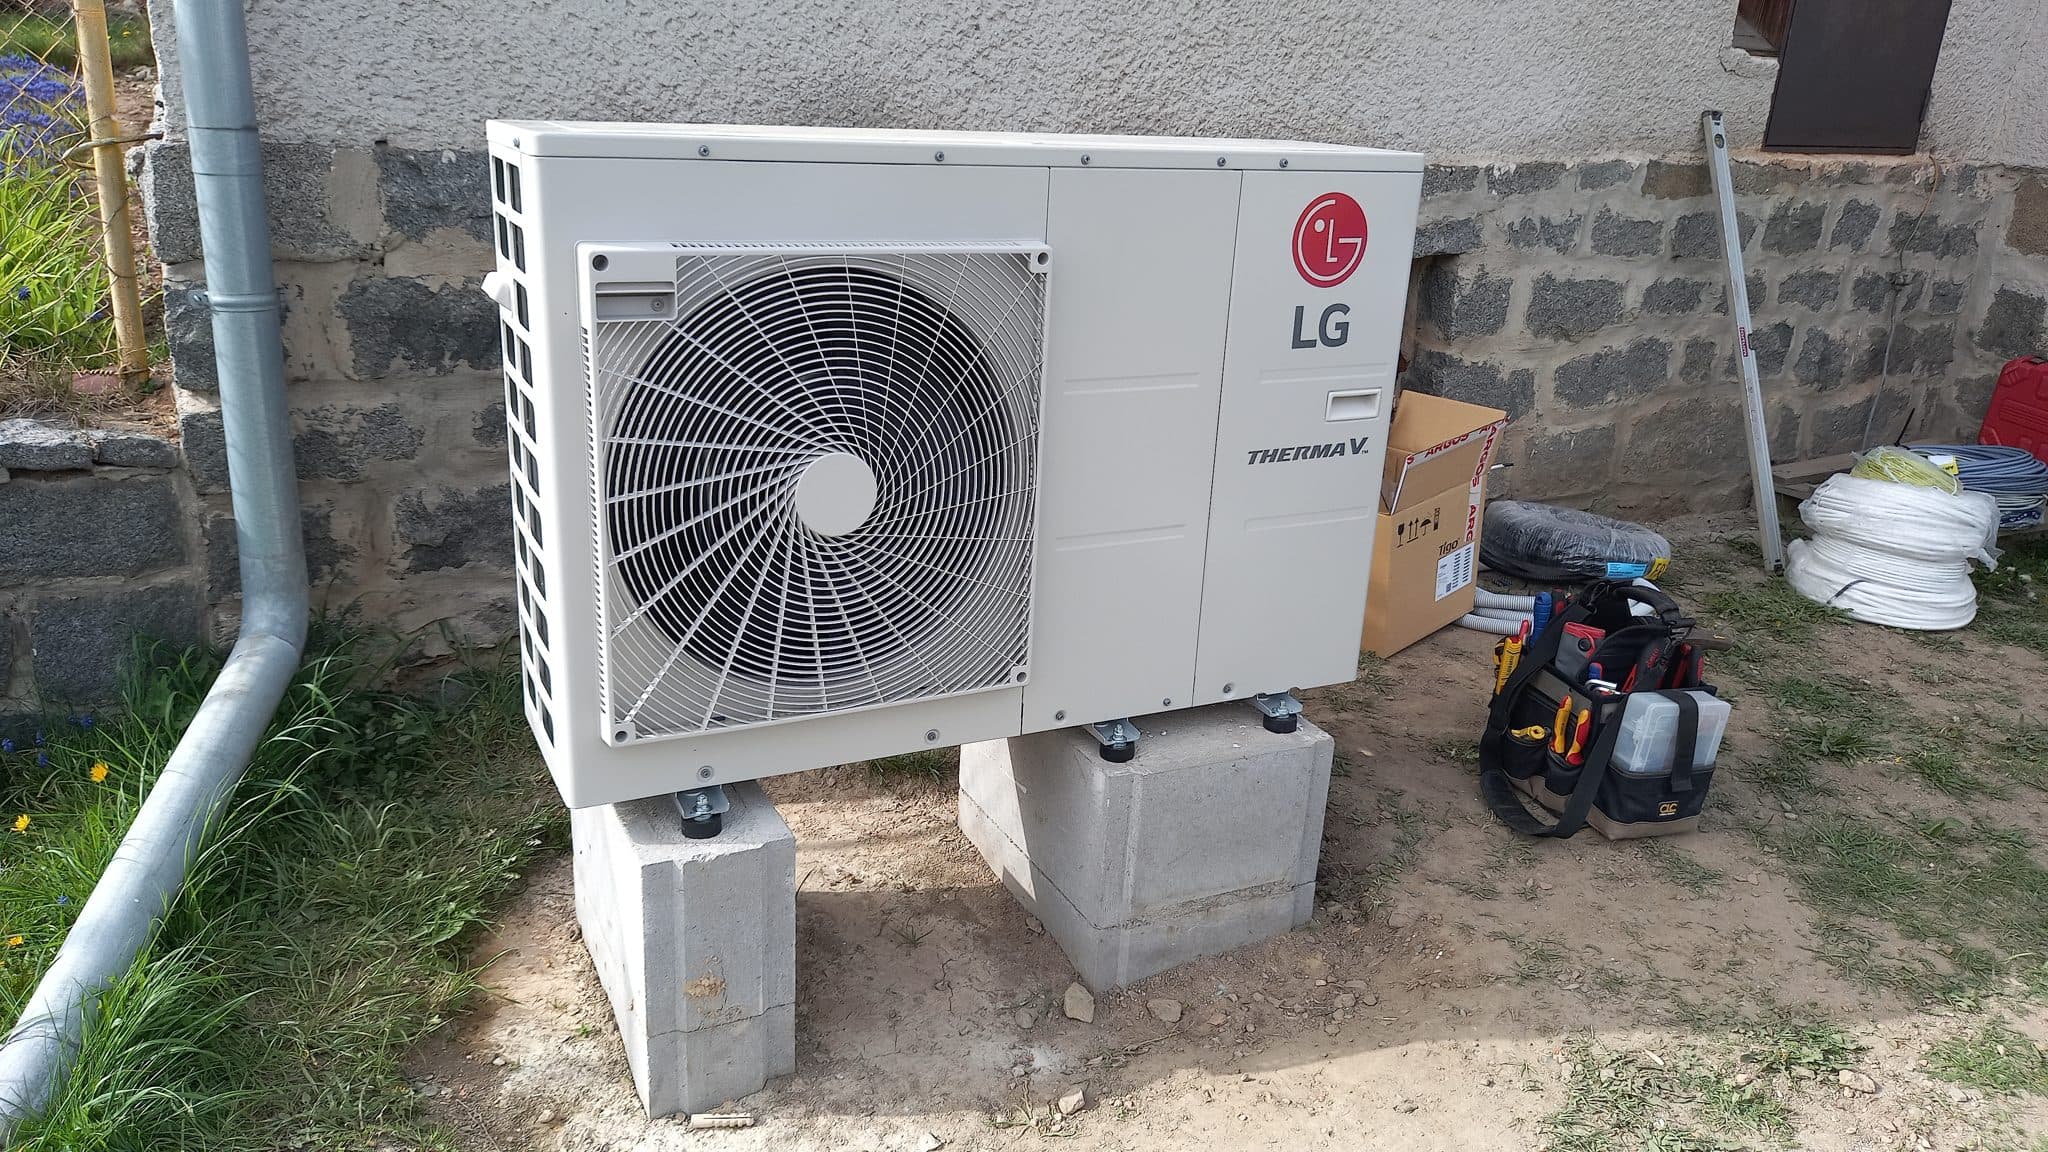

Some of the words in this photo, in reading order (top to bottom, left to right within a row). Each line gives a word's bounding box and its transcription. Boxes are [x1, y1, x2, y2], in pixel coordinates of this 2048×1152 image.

[1291, 303, 1350, 349] LG
[1248, 442, 1345, 465] THERMA
[1472, 425, 1497, 488] ARGOS
[1438, 540, 1459, 556] Tigo
